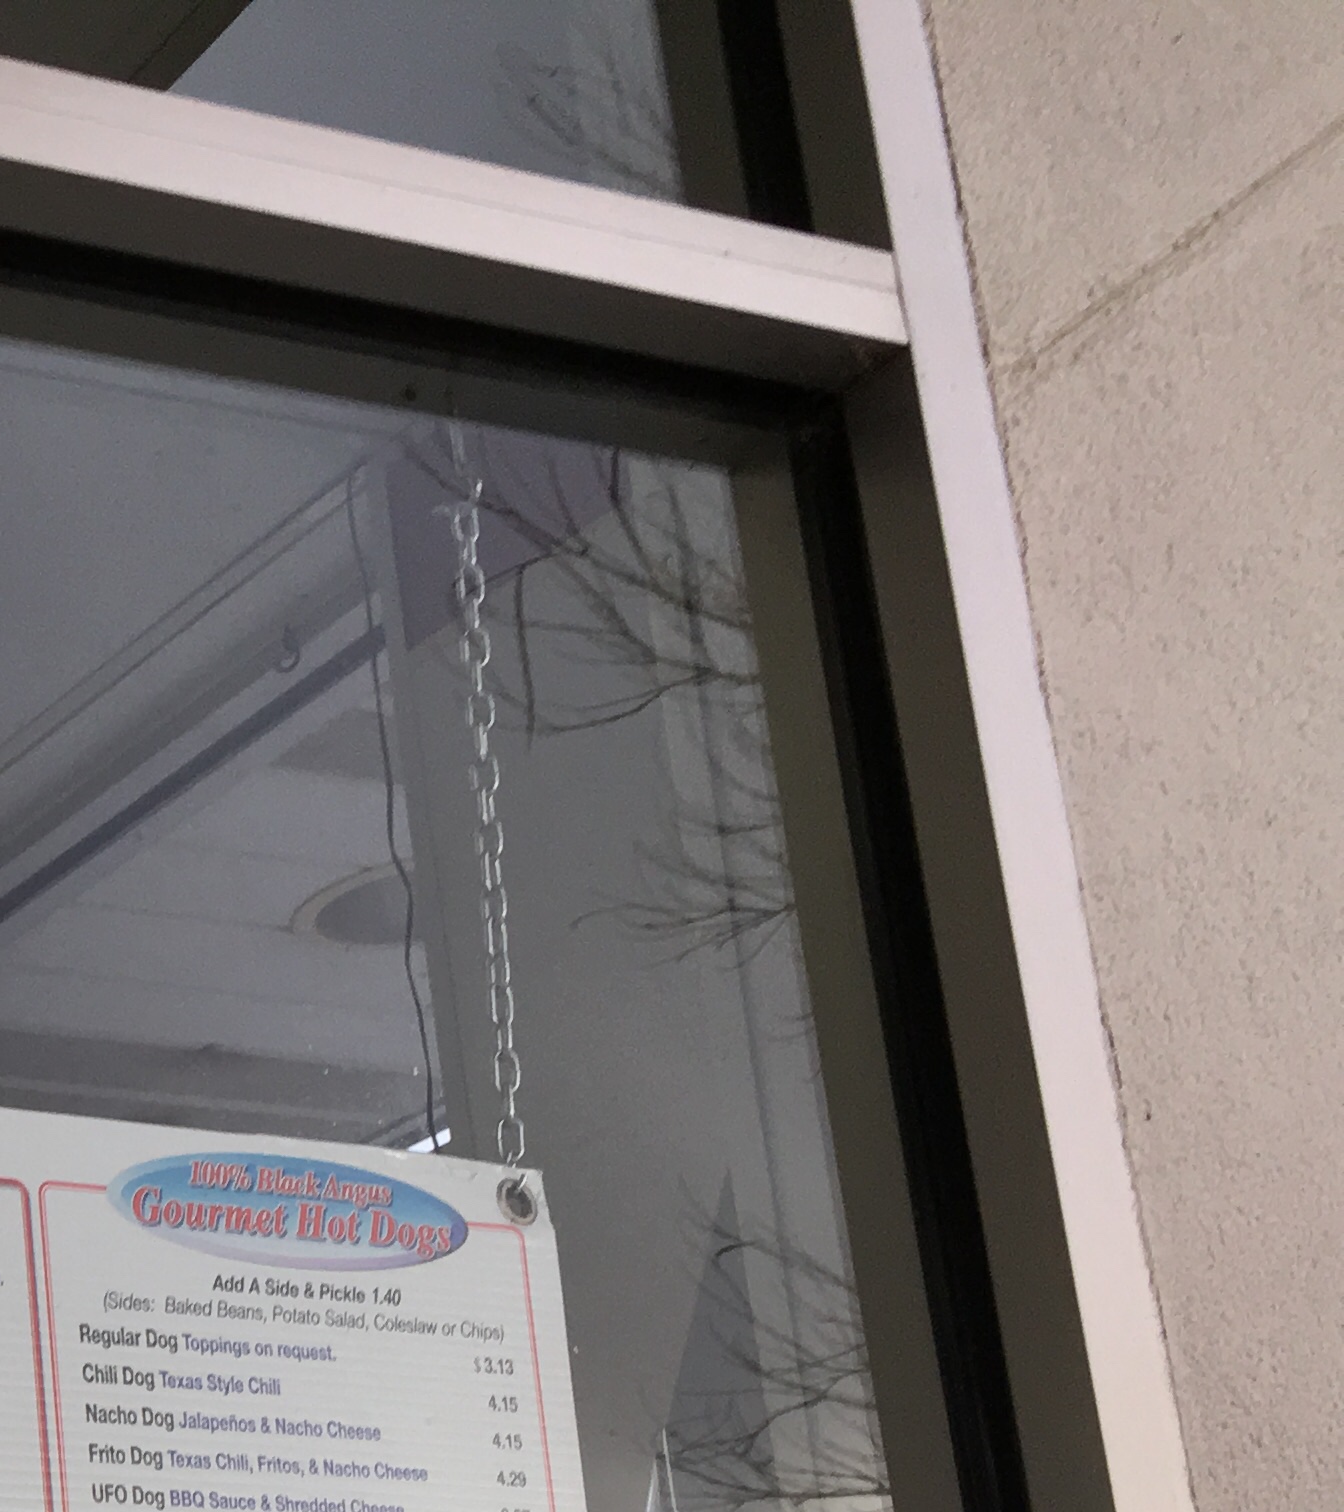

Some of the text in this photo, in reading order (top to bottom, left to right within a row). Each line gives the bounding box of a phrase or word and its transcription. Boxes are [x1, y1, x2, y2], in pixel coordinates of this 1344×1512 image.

[132, 1185, 453, 1260] Gourmet Hot Dogs
[83, 1363, 280, 1396] Chili Dog Texas Style Chili
